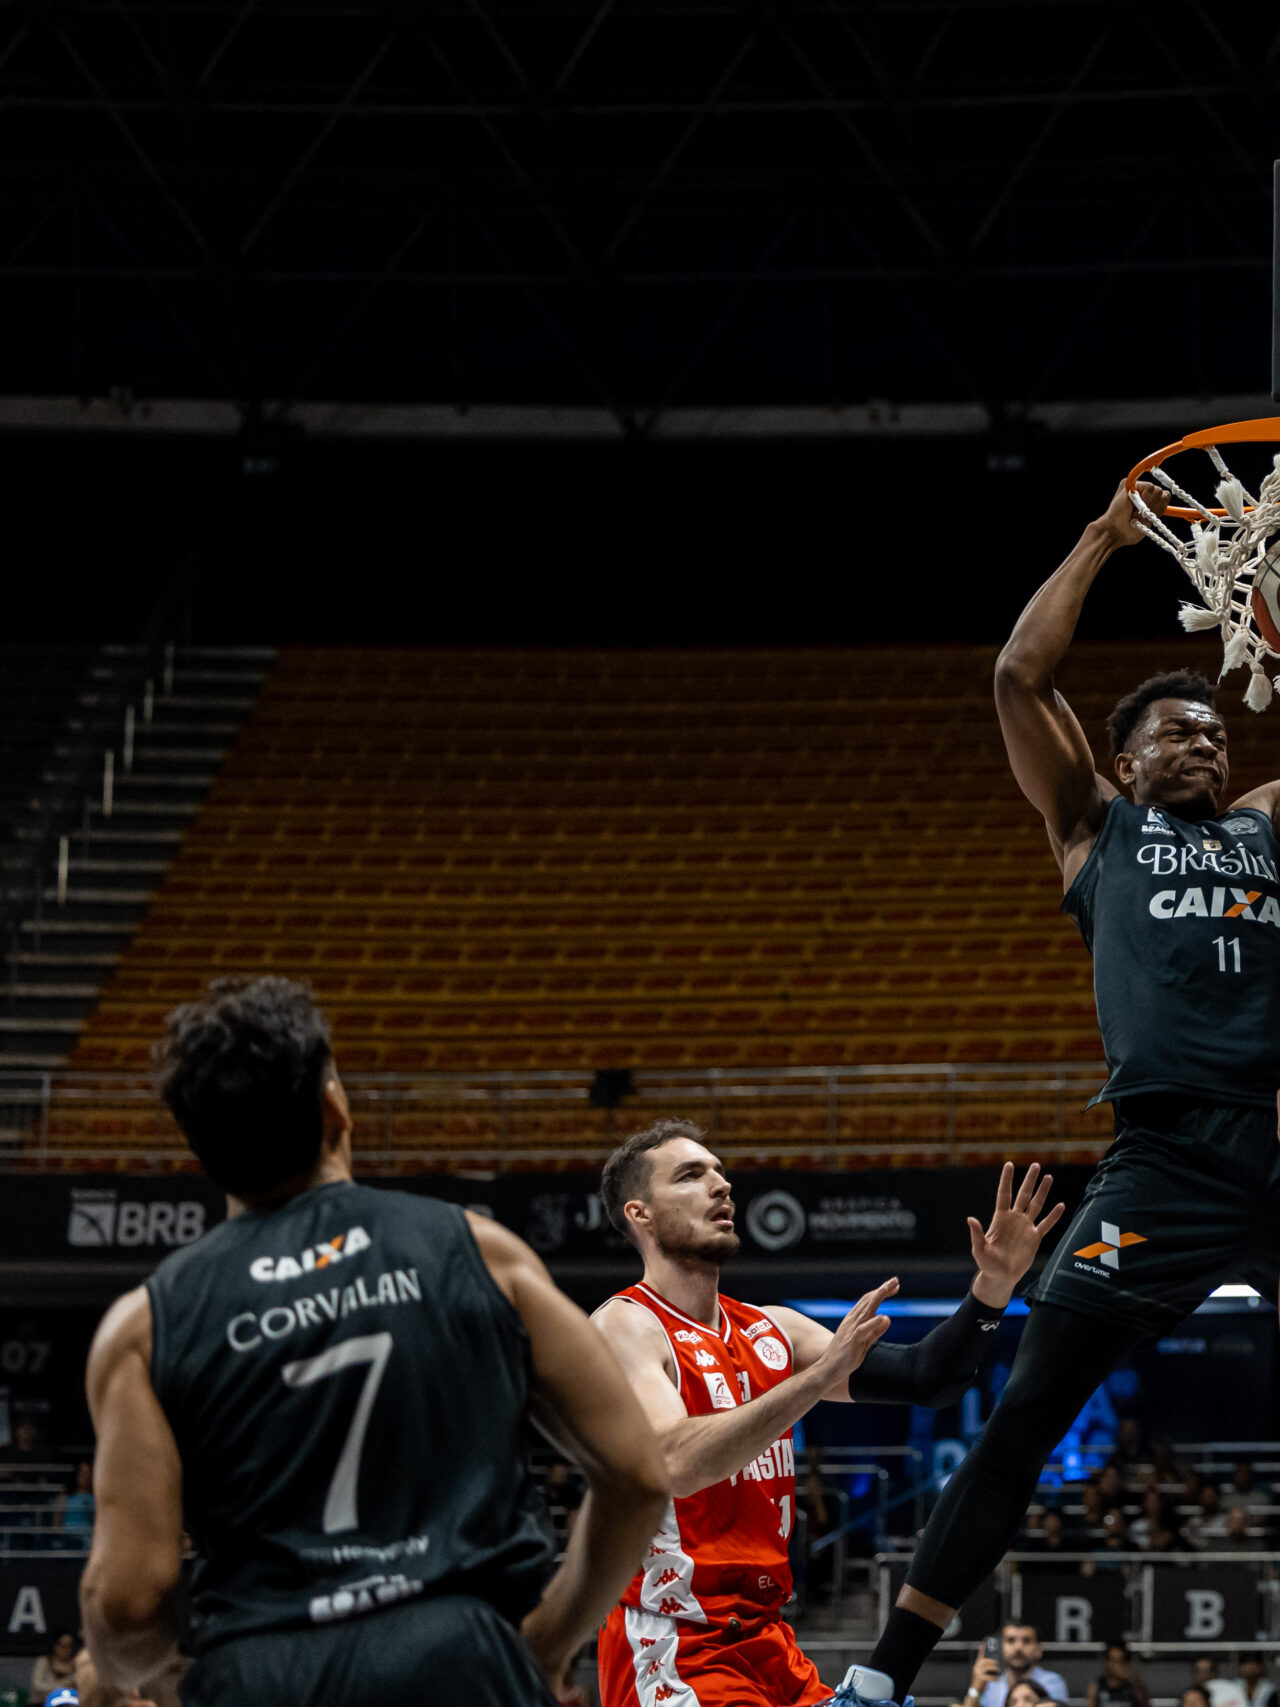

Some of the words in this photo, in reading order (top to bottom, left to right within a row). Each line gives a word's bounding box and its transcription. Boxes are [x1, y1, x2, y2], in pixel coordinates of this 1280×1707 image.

[1211, 935, 1242, 973] 11
[115, 1201, 207, 1247] BRB
[249, 1225, 372, 1282] CAIXA
[226, 1267, 422, 1353] CORVALAN
[281, 1331, 393, 1534] 7
[7, 1586, 48, 1635] A
[1055, 1596, 1093, 1642] R
[1183, 1589, 1226, 1639] B
